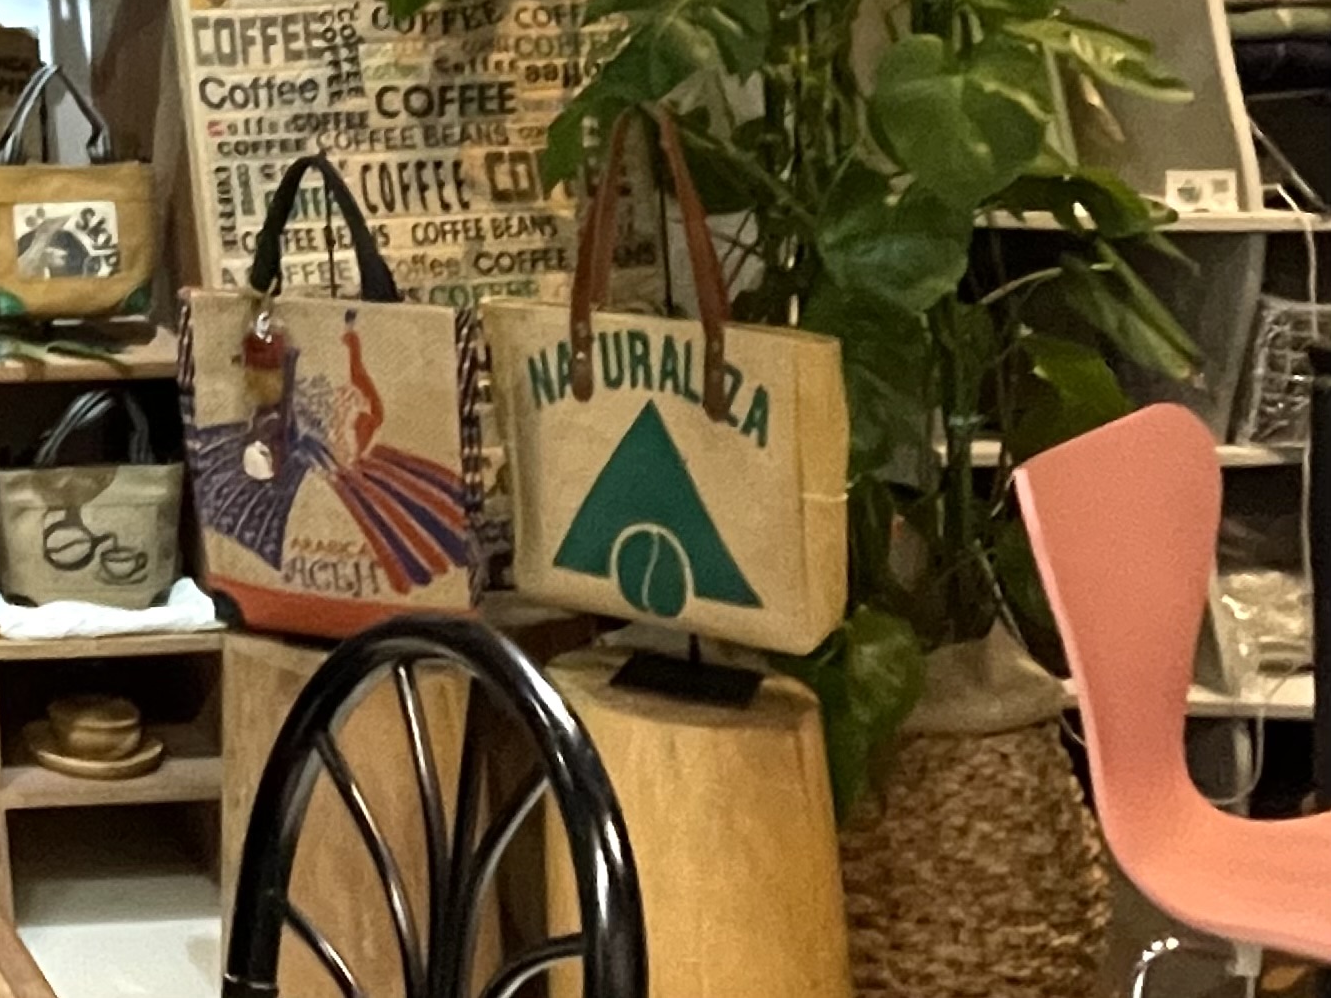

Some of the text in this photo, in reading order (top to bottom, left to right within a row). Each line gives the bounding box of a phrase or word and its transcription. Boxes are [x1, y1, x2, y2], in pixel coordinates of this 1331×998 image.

[191, 11, 327, 67] COFFEE
[199, 76, 517, 119] Coffee COFFEE
[317, 122, 417, 153] COFFEE
[424, 117, 509, 148] BEANS
[360, 160, 470, 214] COFFEE
[412, 219, 485, 246] COFFEE
[492, 214, 558, 241] BEANS
[474, 248, 569, 274] COFFEE
[527, 328, 769, 449] NAURALZA
